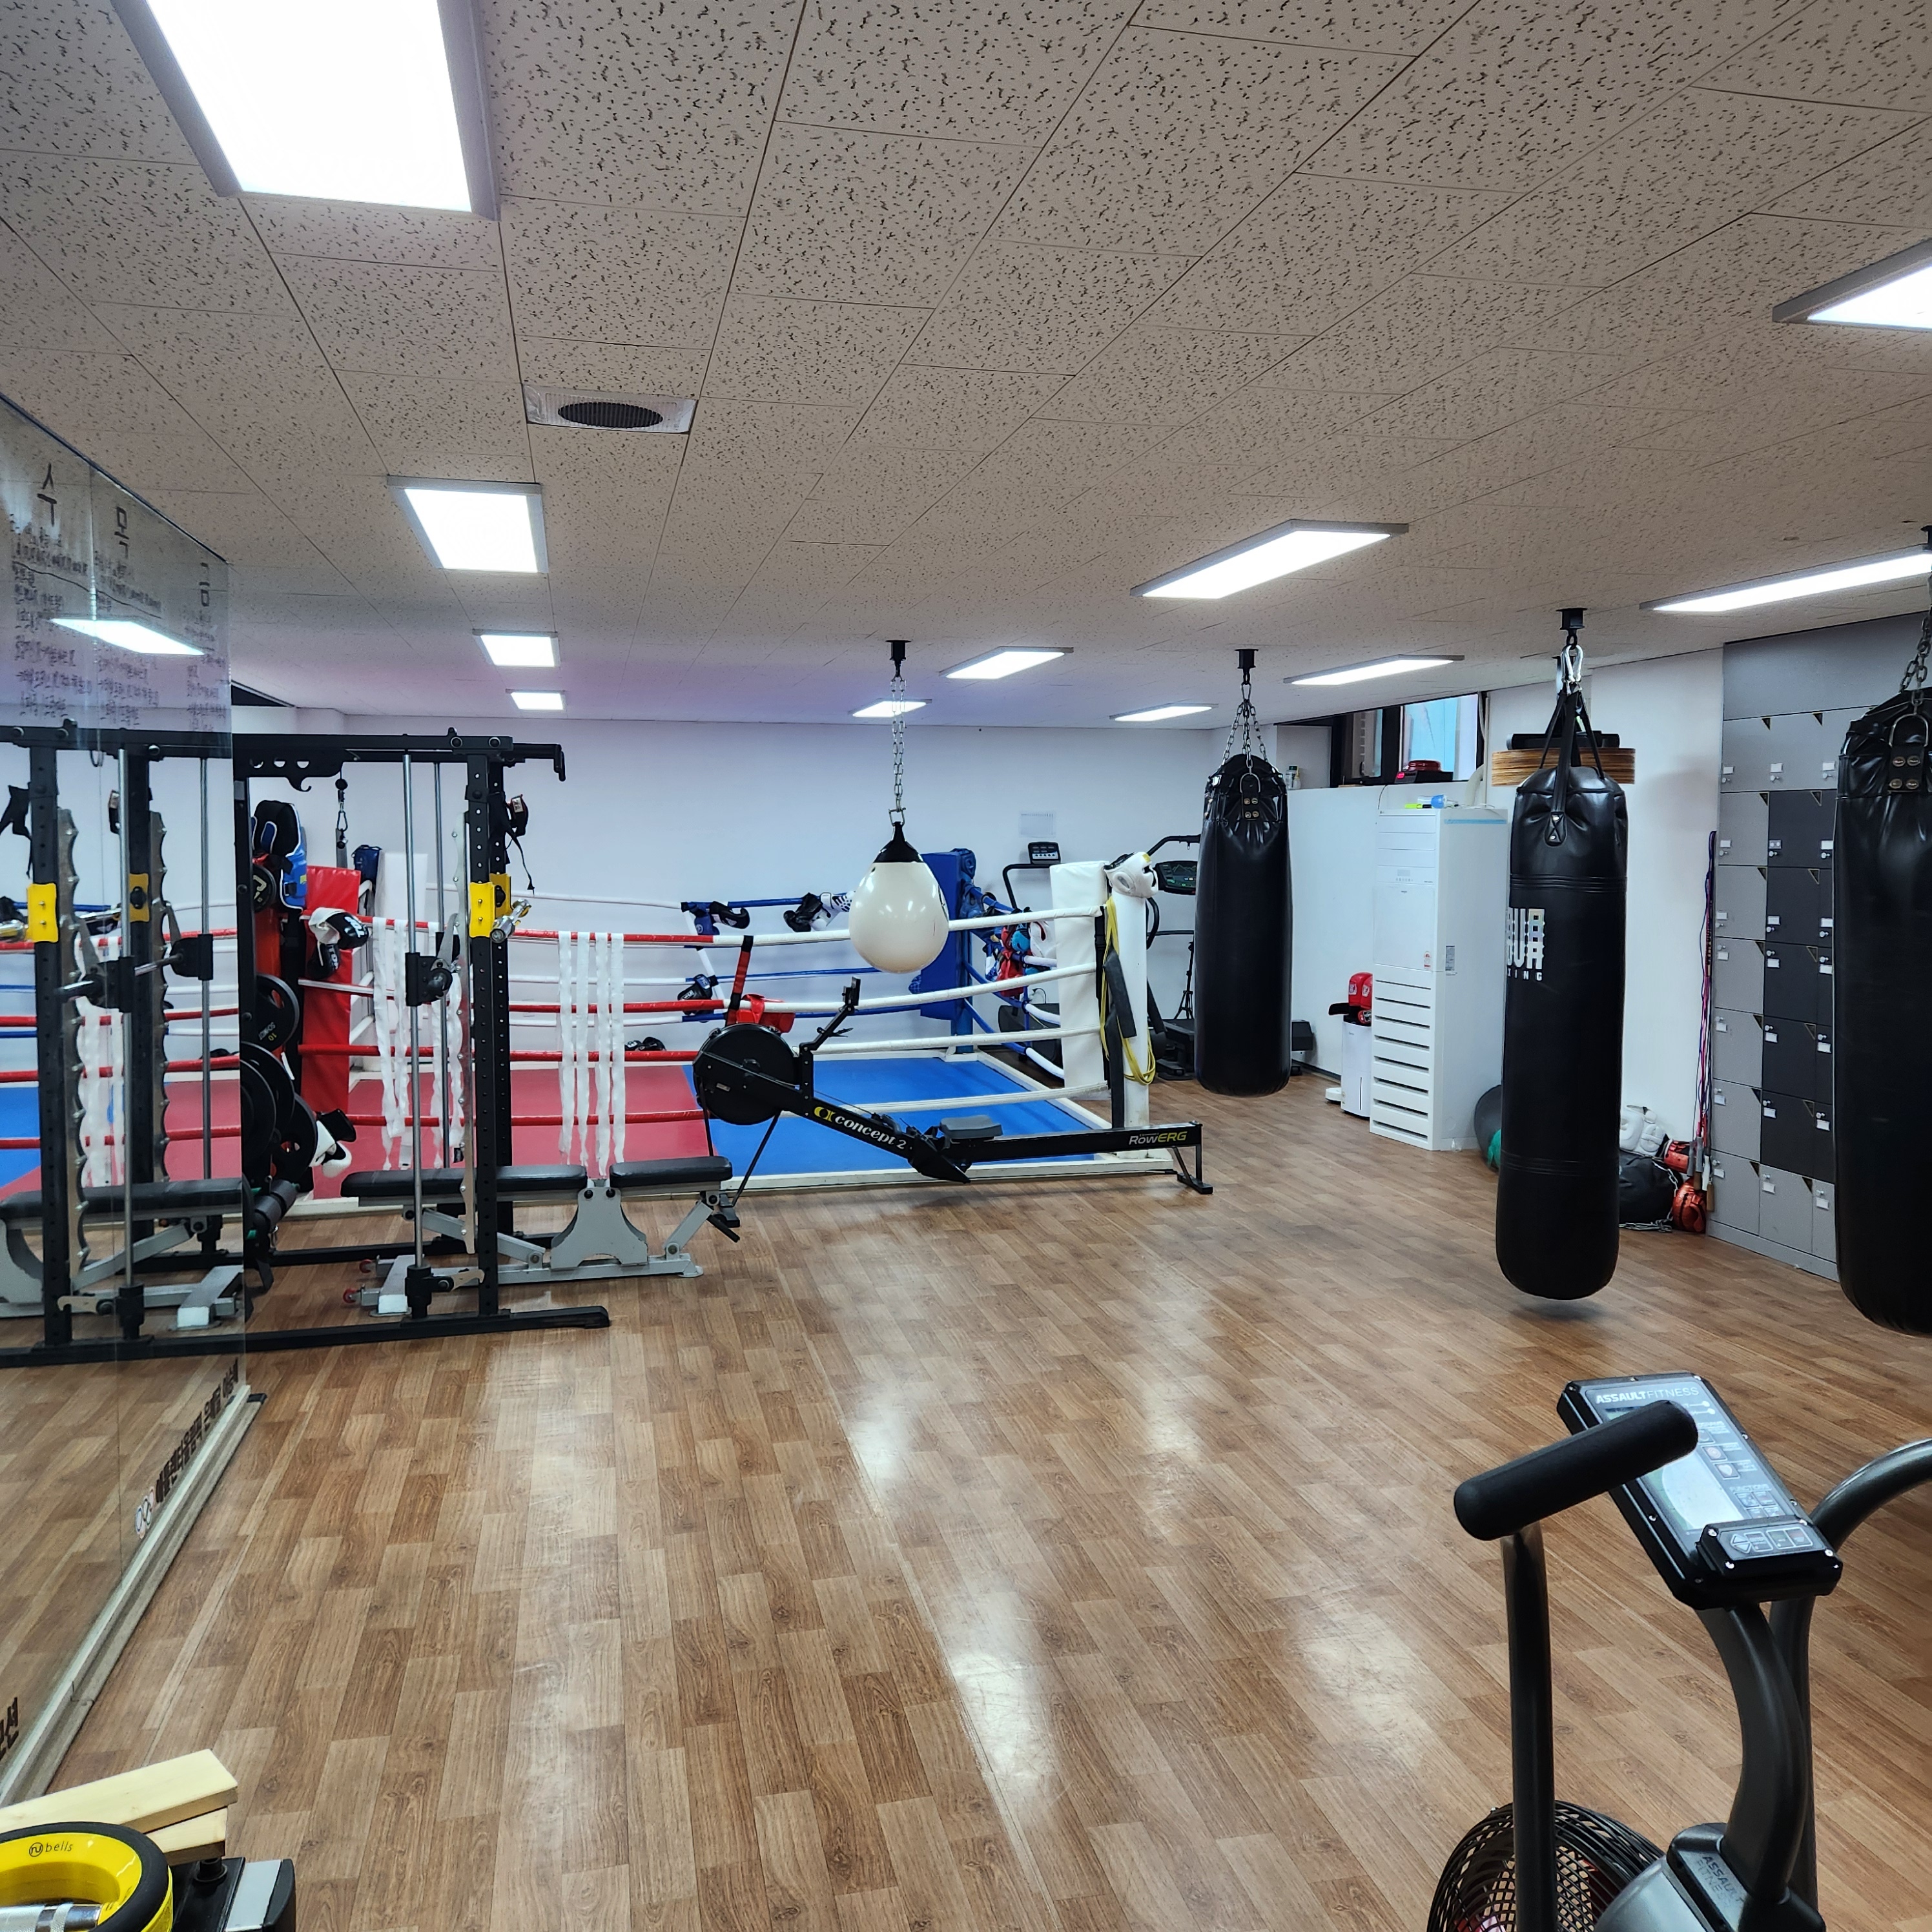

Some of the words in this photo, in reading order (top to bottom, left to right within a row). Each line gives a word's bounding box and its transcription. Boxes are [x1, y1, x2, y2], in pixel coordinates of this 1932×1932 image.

[37, 462, 57, 527] 수
[114, 506, 130, 559] 목
[835, 1116, 897, 1145] concept
[897, 1140, 907, 1149] 2
[46, 1841, 74, 1852] bells
